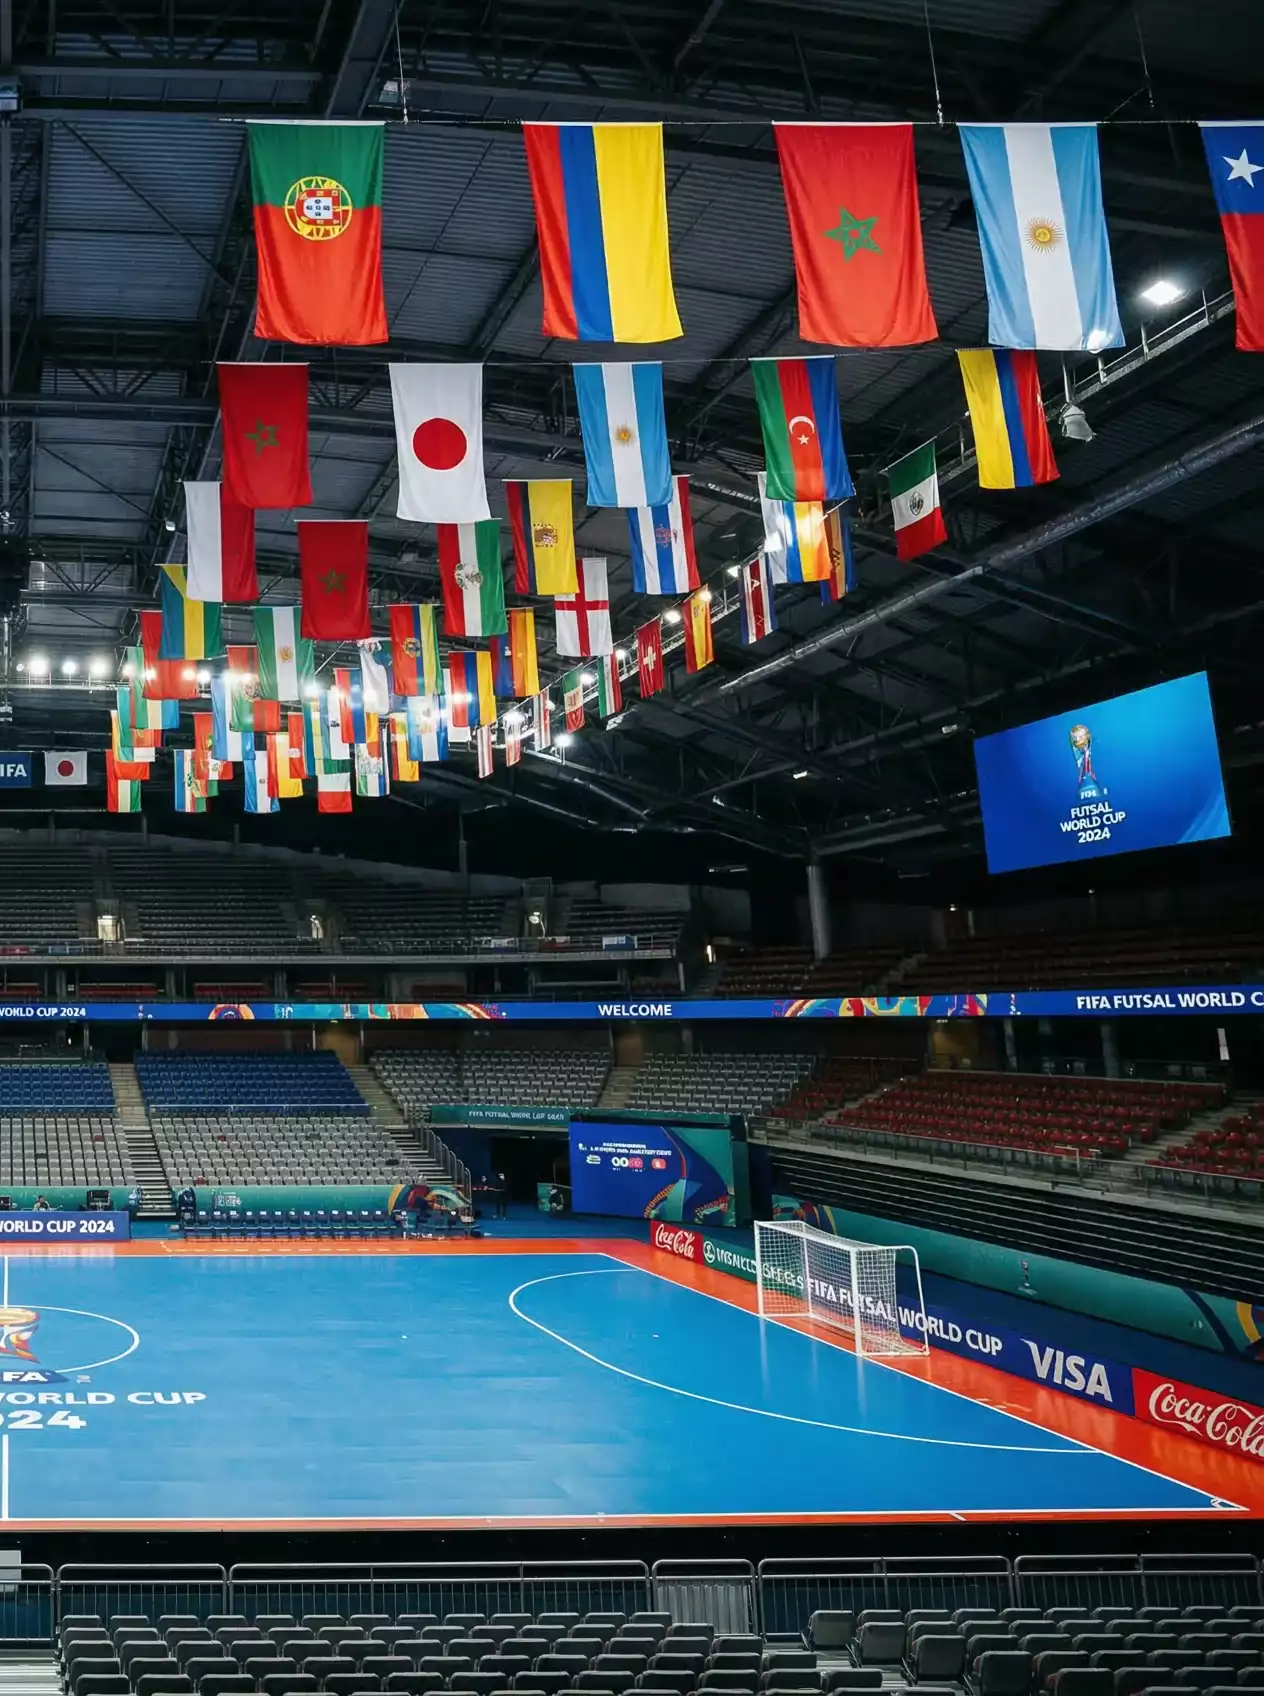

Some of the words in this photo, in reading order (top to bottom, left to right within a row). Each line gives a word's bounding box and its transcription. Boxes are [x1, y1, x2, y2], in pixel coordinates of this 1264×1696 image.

[1070, 801, 1113, 819] FUTSAL
[1059, 816, 1102, 832] WORLD
[1102, 811, 1126, 825] CUP
[1077, 826, 1111, 843] 2024
[1076, 995, 1112, 1010] FIFA
[1113, 994, 1176, 1009] FUTSAL
[1177, 992, 1246, 1008] WORLD
[36, 1007, 58, 1017] CUP
[60, 1007, 86, 1017] 2024
[598, 1004, 672, 1017] WELCOME
[46, 1220, 77, 1233] CUP
[79, 1220, 115, 1233] 2024
[808, 1278, 837, 1302] FIFA
[898, 1306, 962, 1343] WORLD
[965, 1328, 1003, 1356] CUP
[1020, 1338, 1113, 1403] VISA
[126, 1392, 207, 1405] CUP
